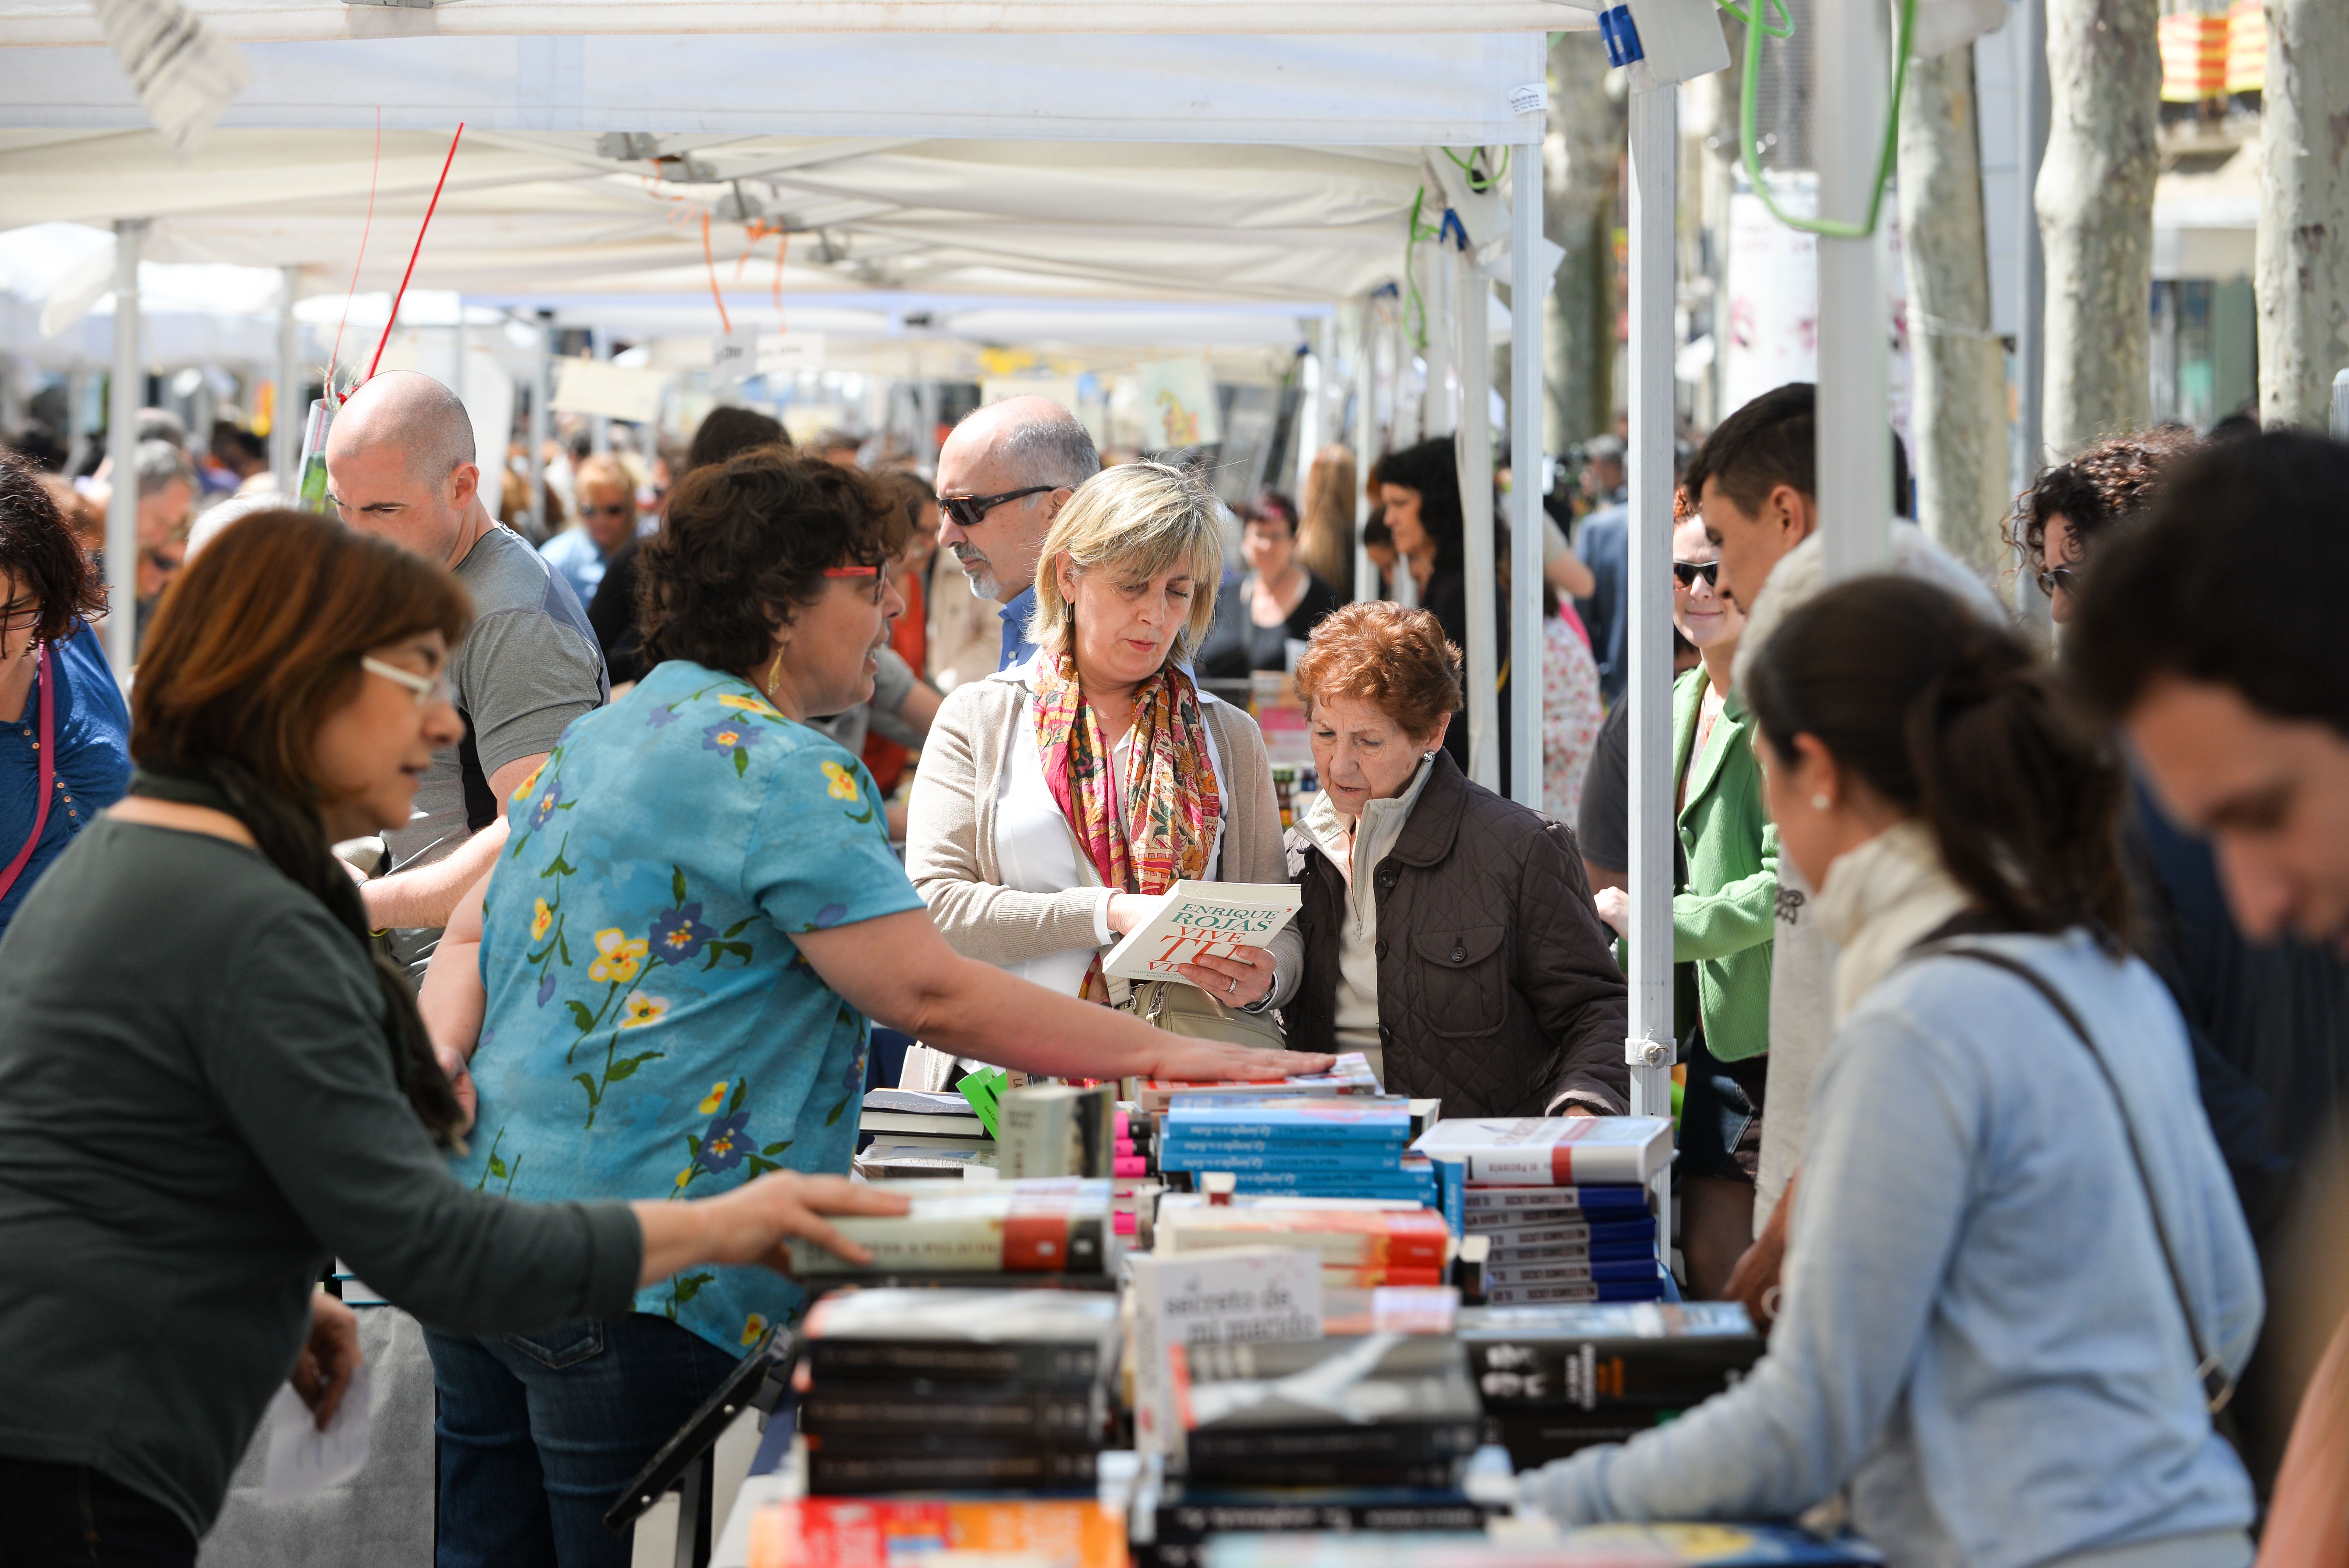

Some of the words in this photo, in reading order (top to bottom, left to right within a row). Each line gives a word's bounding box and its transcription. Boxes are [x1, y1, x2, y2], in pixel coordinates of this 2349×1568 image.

[1180, 903, 1280, 919] ENRIQUE
[1169, 912, 1273, 932] ROJAS
[1180, 926, 1246, 943] VIVE
[1152, 935, 1246, 965] TU
[1148, 961, 1178, 972] VI
[1013, 1078, 1023, 1088] LA
[984, 1105, 992, 1115] José
[1166, 1291, 1255, 1317] secreto
[1260, 1278, 1291, 1308] de
[1226, 1309, 1317, 1342] marido
